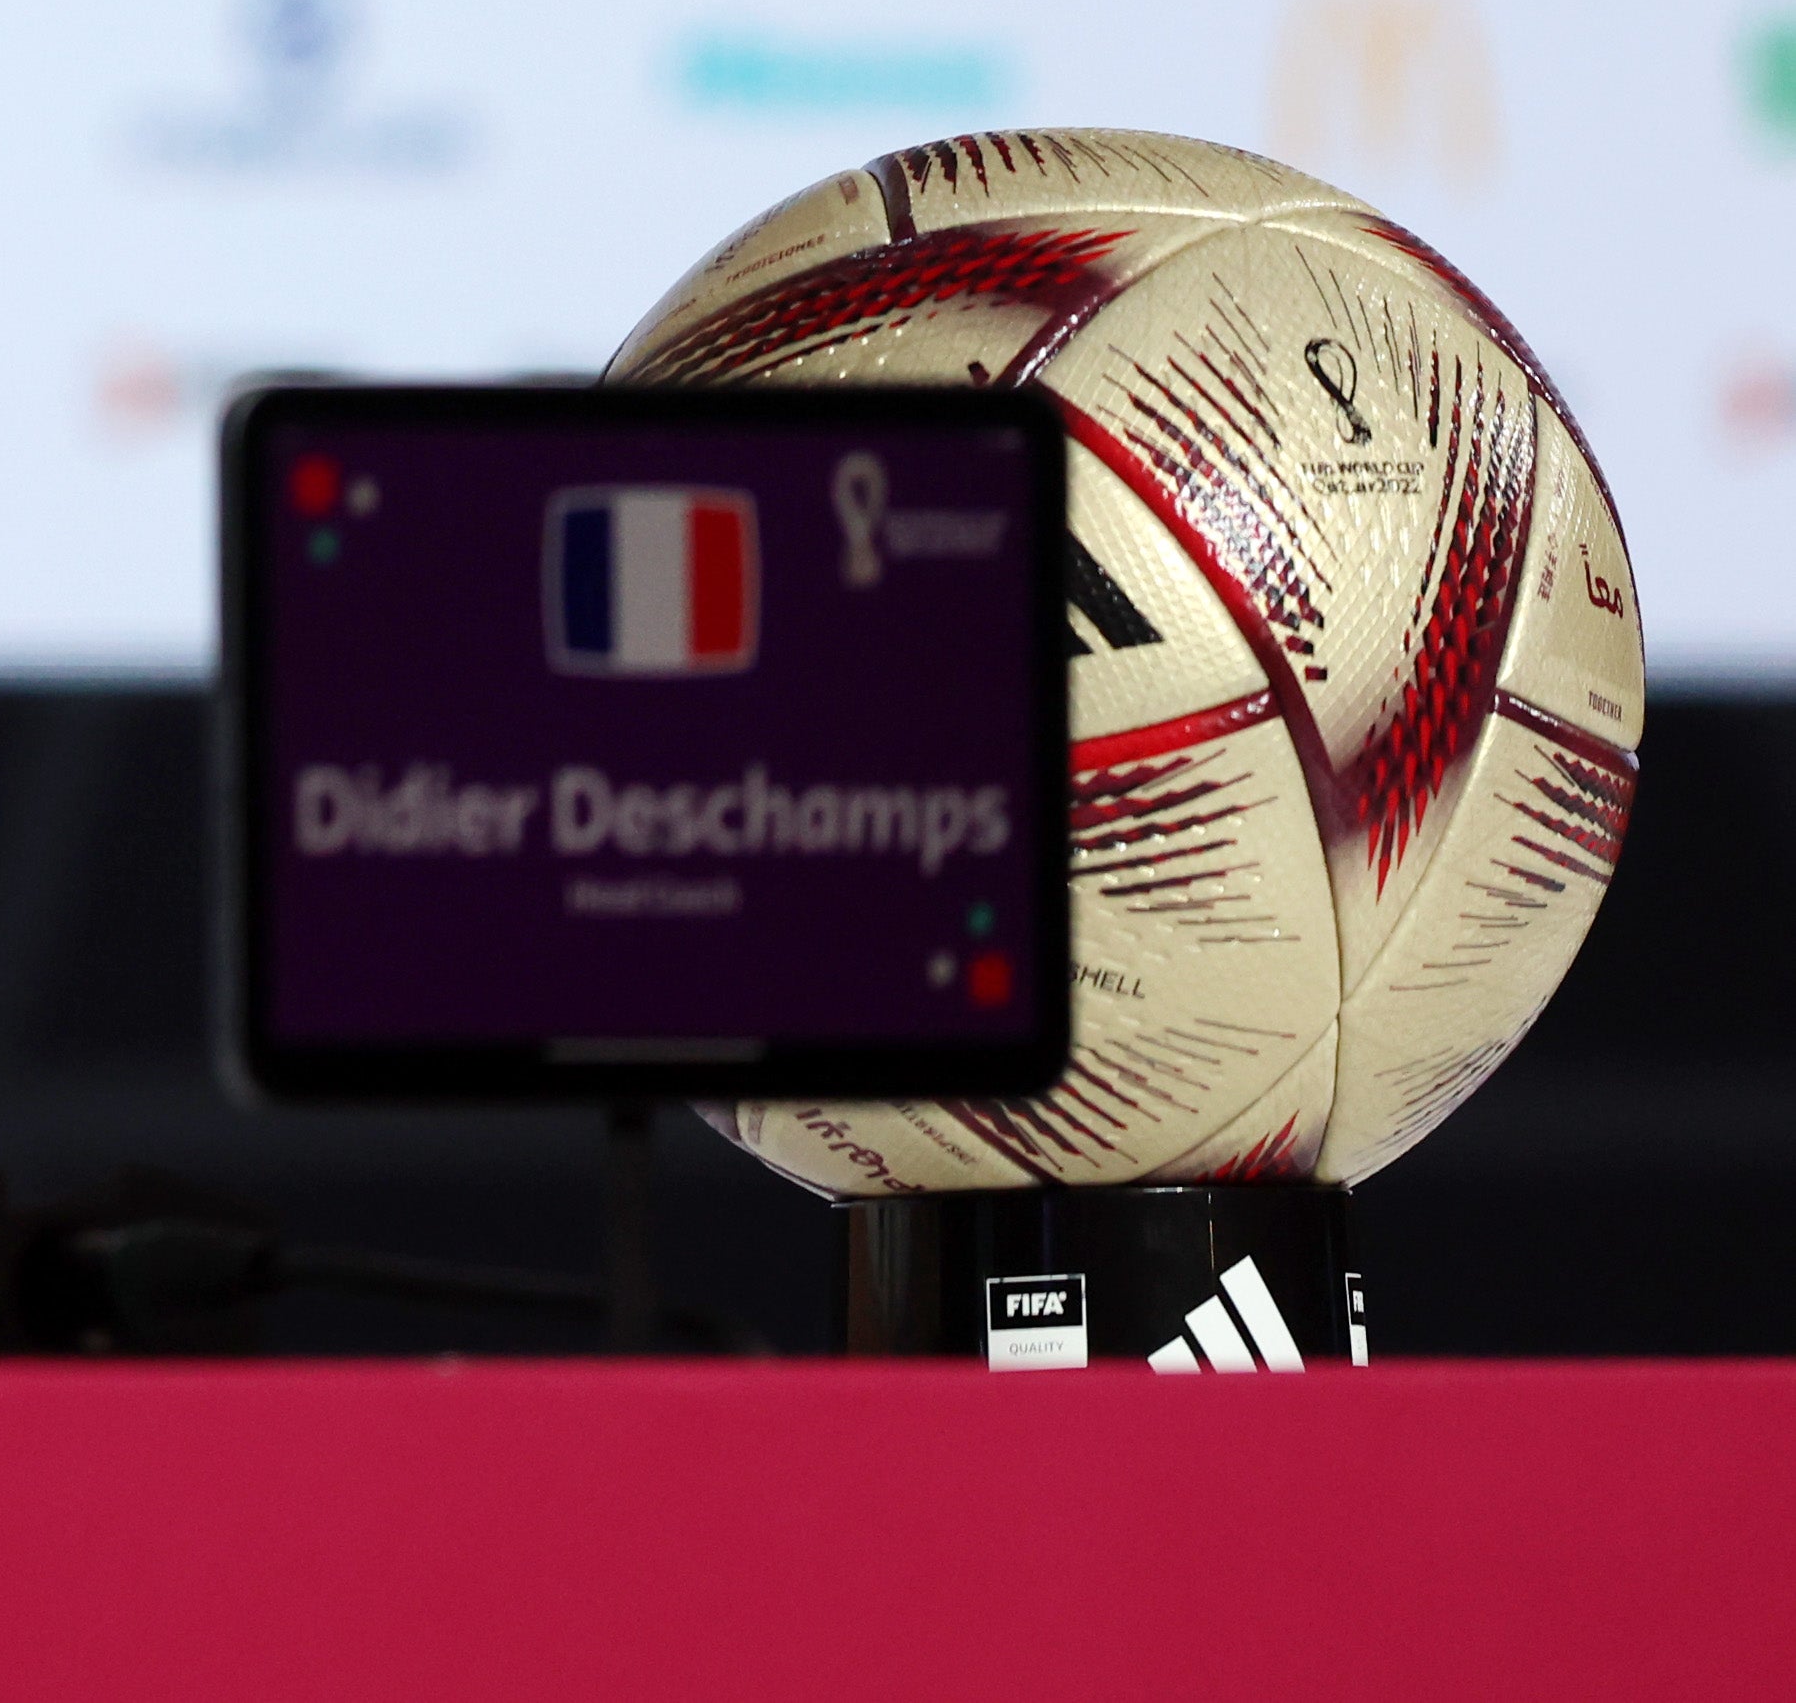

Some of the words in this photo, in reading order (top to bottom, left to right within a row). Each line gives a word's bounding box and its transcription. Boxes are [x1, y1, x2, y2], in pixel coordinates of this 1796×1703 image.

[294, 762, 538, 856] Didier
[551, 762, 1009, 876] Deschamps
[1006, 1291, 1067, 1318] FIFA
[1009, 1341, 1065, 1356] QUALITY
